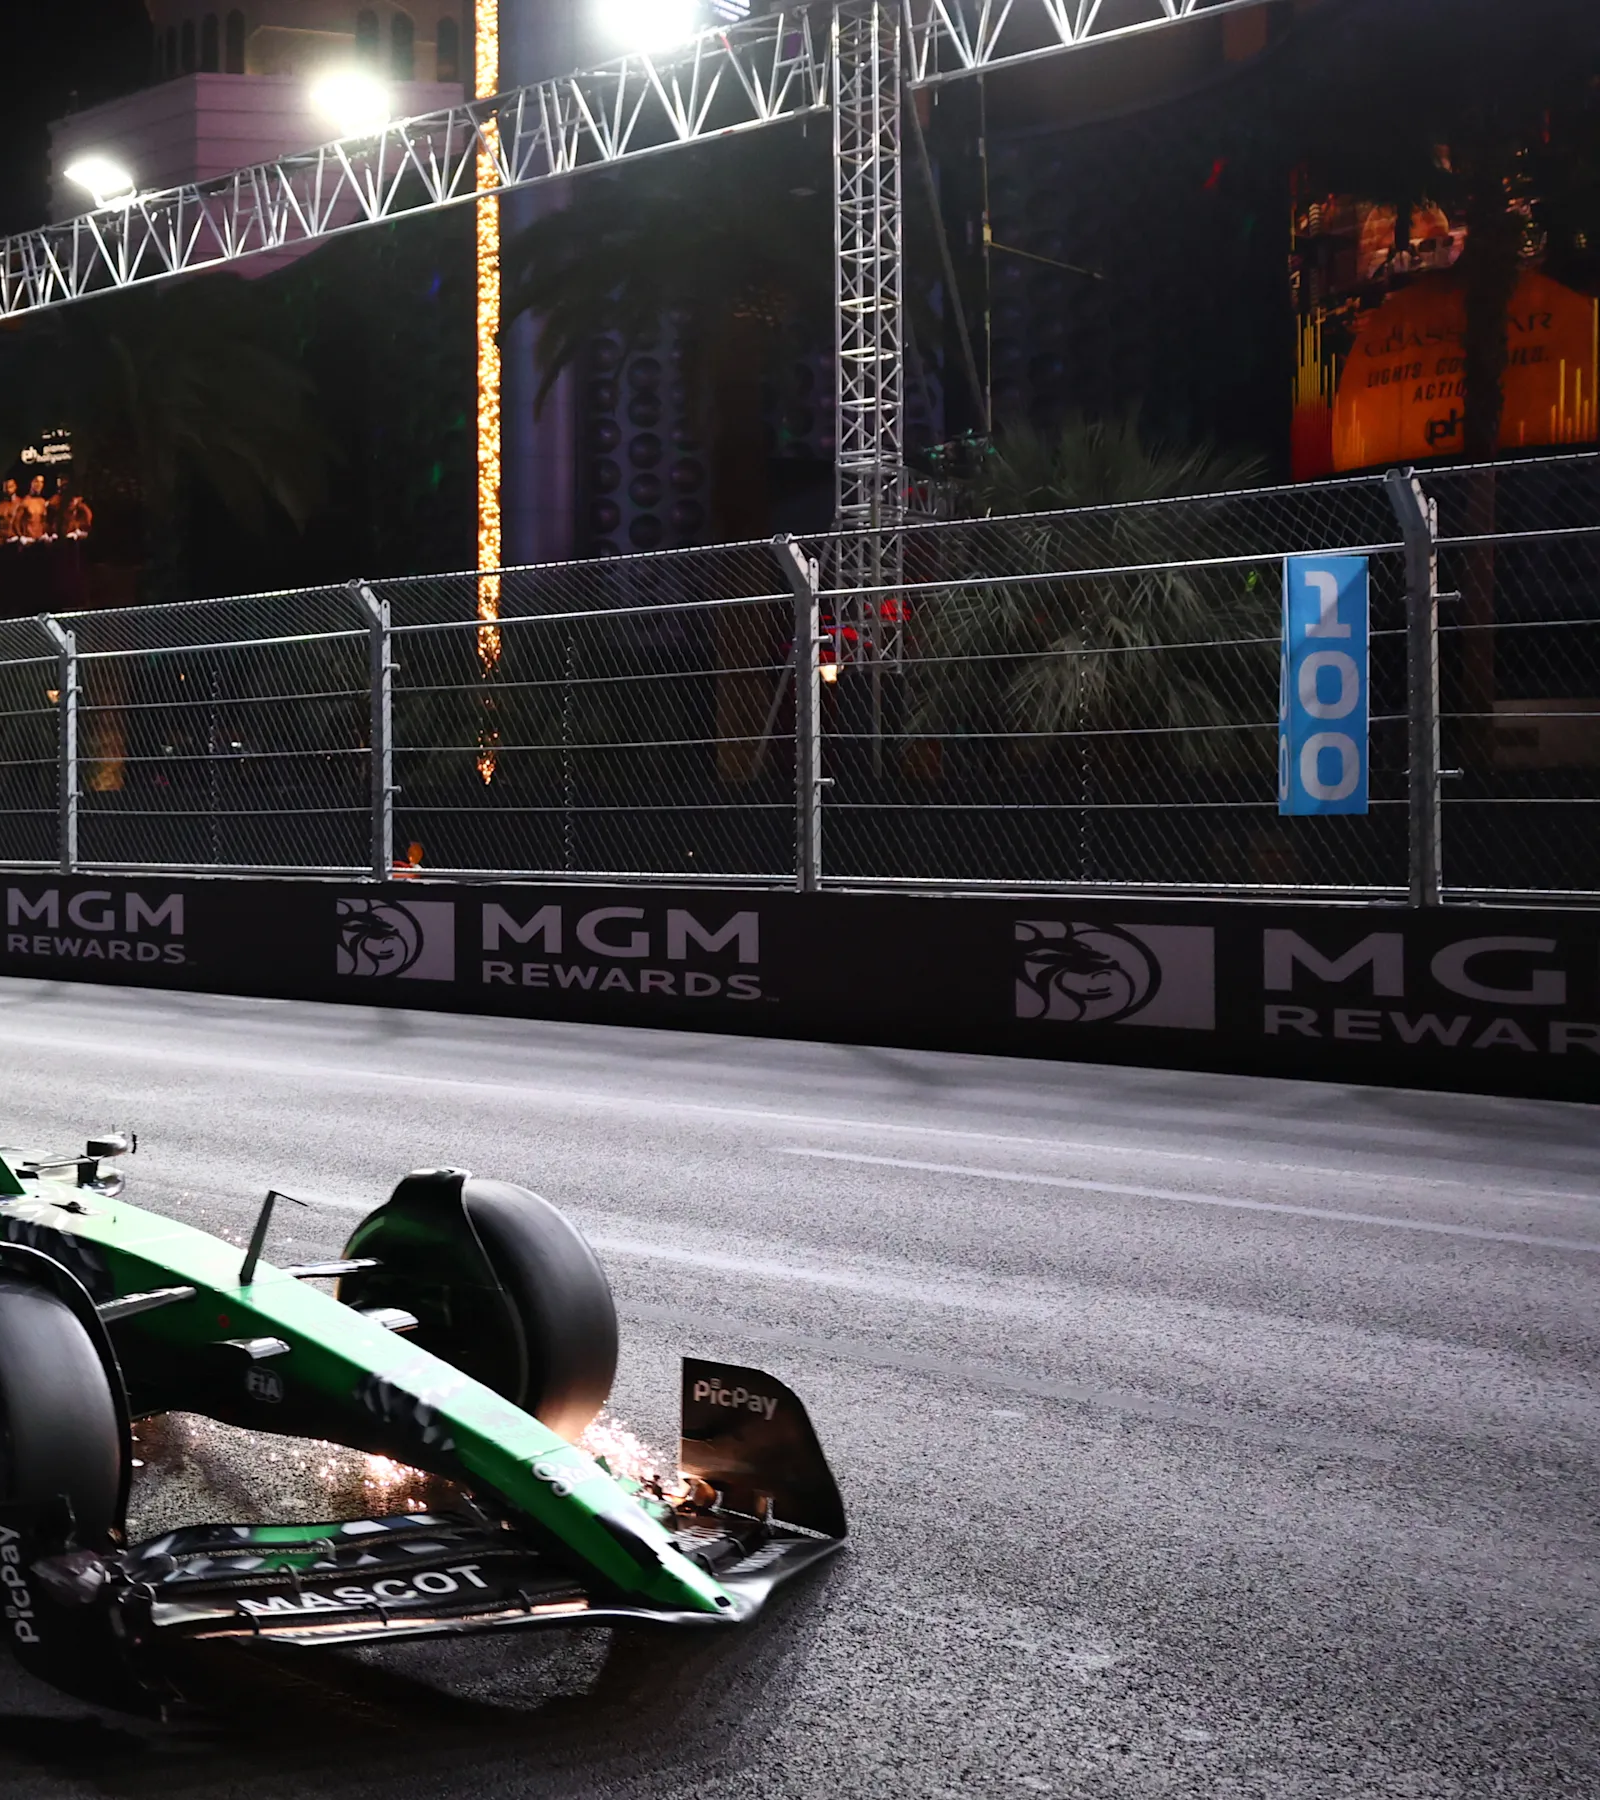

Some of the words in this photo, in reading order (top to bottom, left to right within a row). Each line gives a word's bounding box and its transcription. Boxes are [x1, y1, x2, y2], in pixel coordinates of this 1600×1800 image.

[1297, 570, 1361, 801] 100
[7, 888, 184, 935] MGM
[482, 902, 759, 964] MGM
[7, 933, 185, 965] REWARDS
[1262, 927, 1567, 1006] MG
[482, 960, 763, 1000] REWARDS
[247, 1369, 280, 1399] FIA
[693, 1378, 779, 1421] PicPay
[238, 1563, 490, 1615] MASCOT
